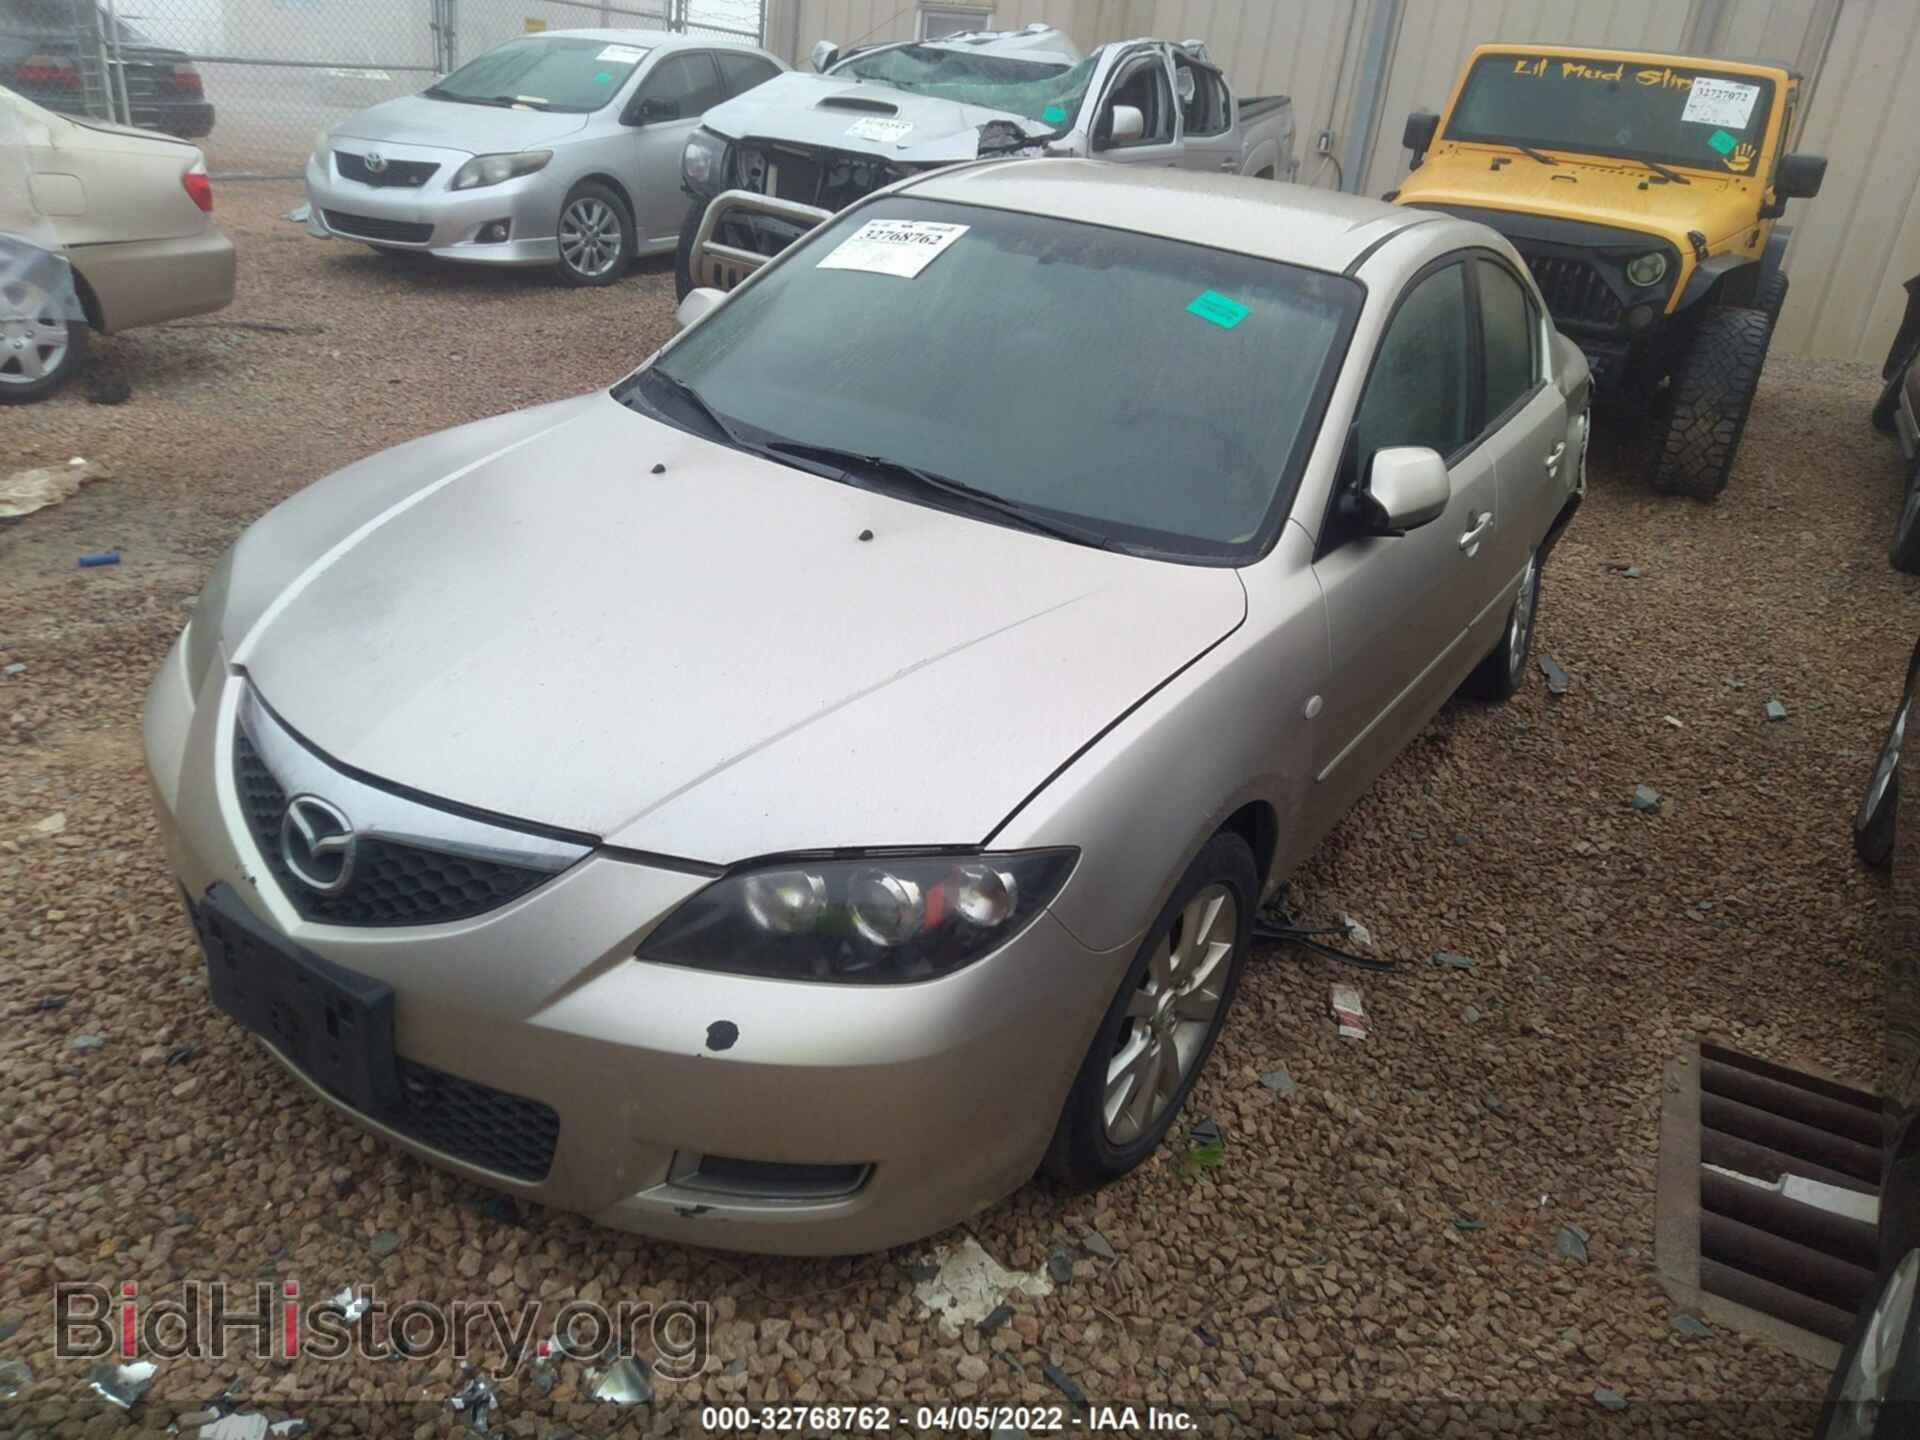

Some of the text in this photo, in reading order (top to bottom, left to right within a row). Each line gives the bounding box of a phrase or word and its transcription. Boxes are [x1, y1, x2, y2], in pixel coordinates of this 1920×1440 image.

[1513, 57, 1549, 78] Lil
[1561, 61, 1625, 81] Mud
[866, 229, 943, 245] 32768762
